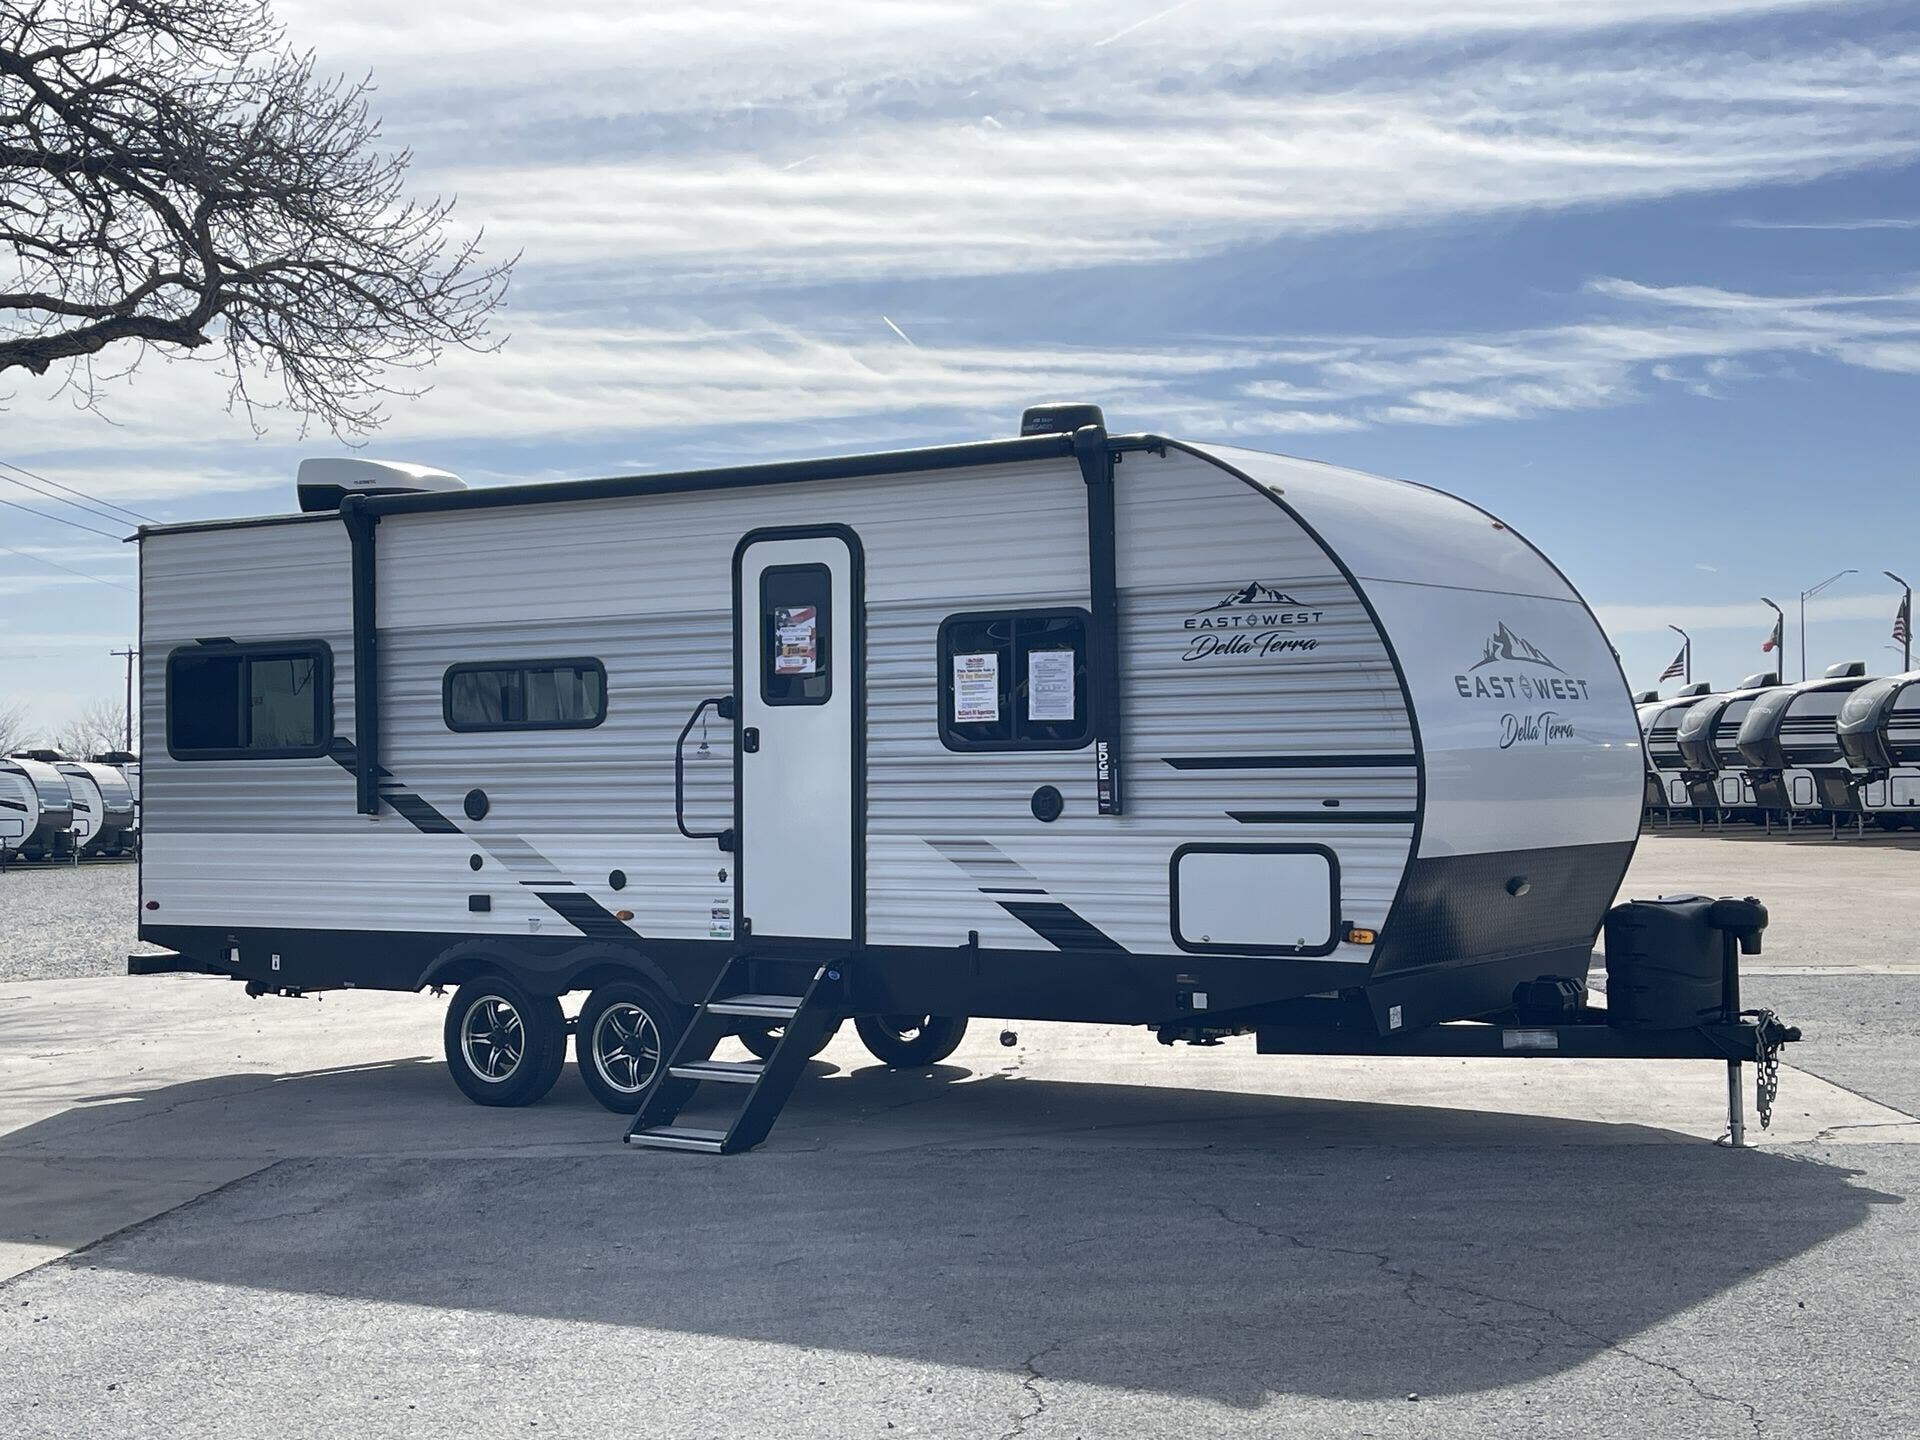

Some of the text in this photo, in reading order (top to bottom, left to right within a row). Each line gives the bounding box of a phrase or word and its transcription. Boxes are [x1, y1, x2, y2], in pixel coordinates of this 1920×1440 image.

[1184, 611, 1323, 629] EAST WEST
[1181, 629, 1319, 662] Della Terra
[1454, 675, 1589, 700] EAST WEST
[1499, 711, 1575, 750] Della Terra
[1098, 742, 1109, 780] EDGE
